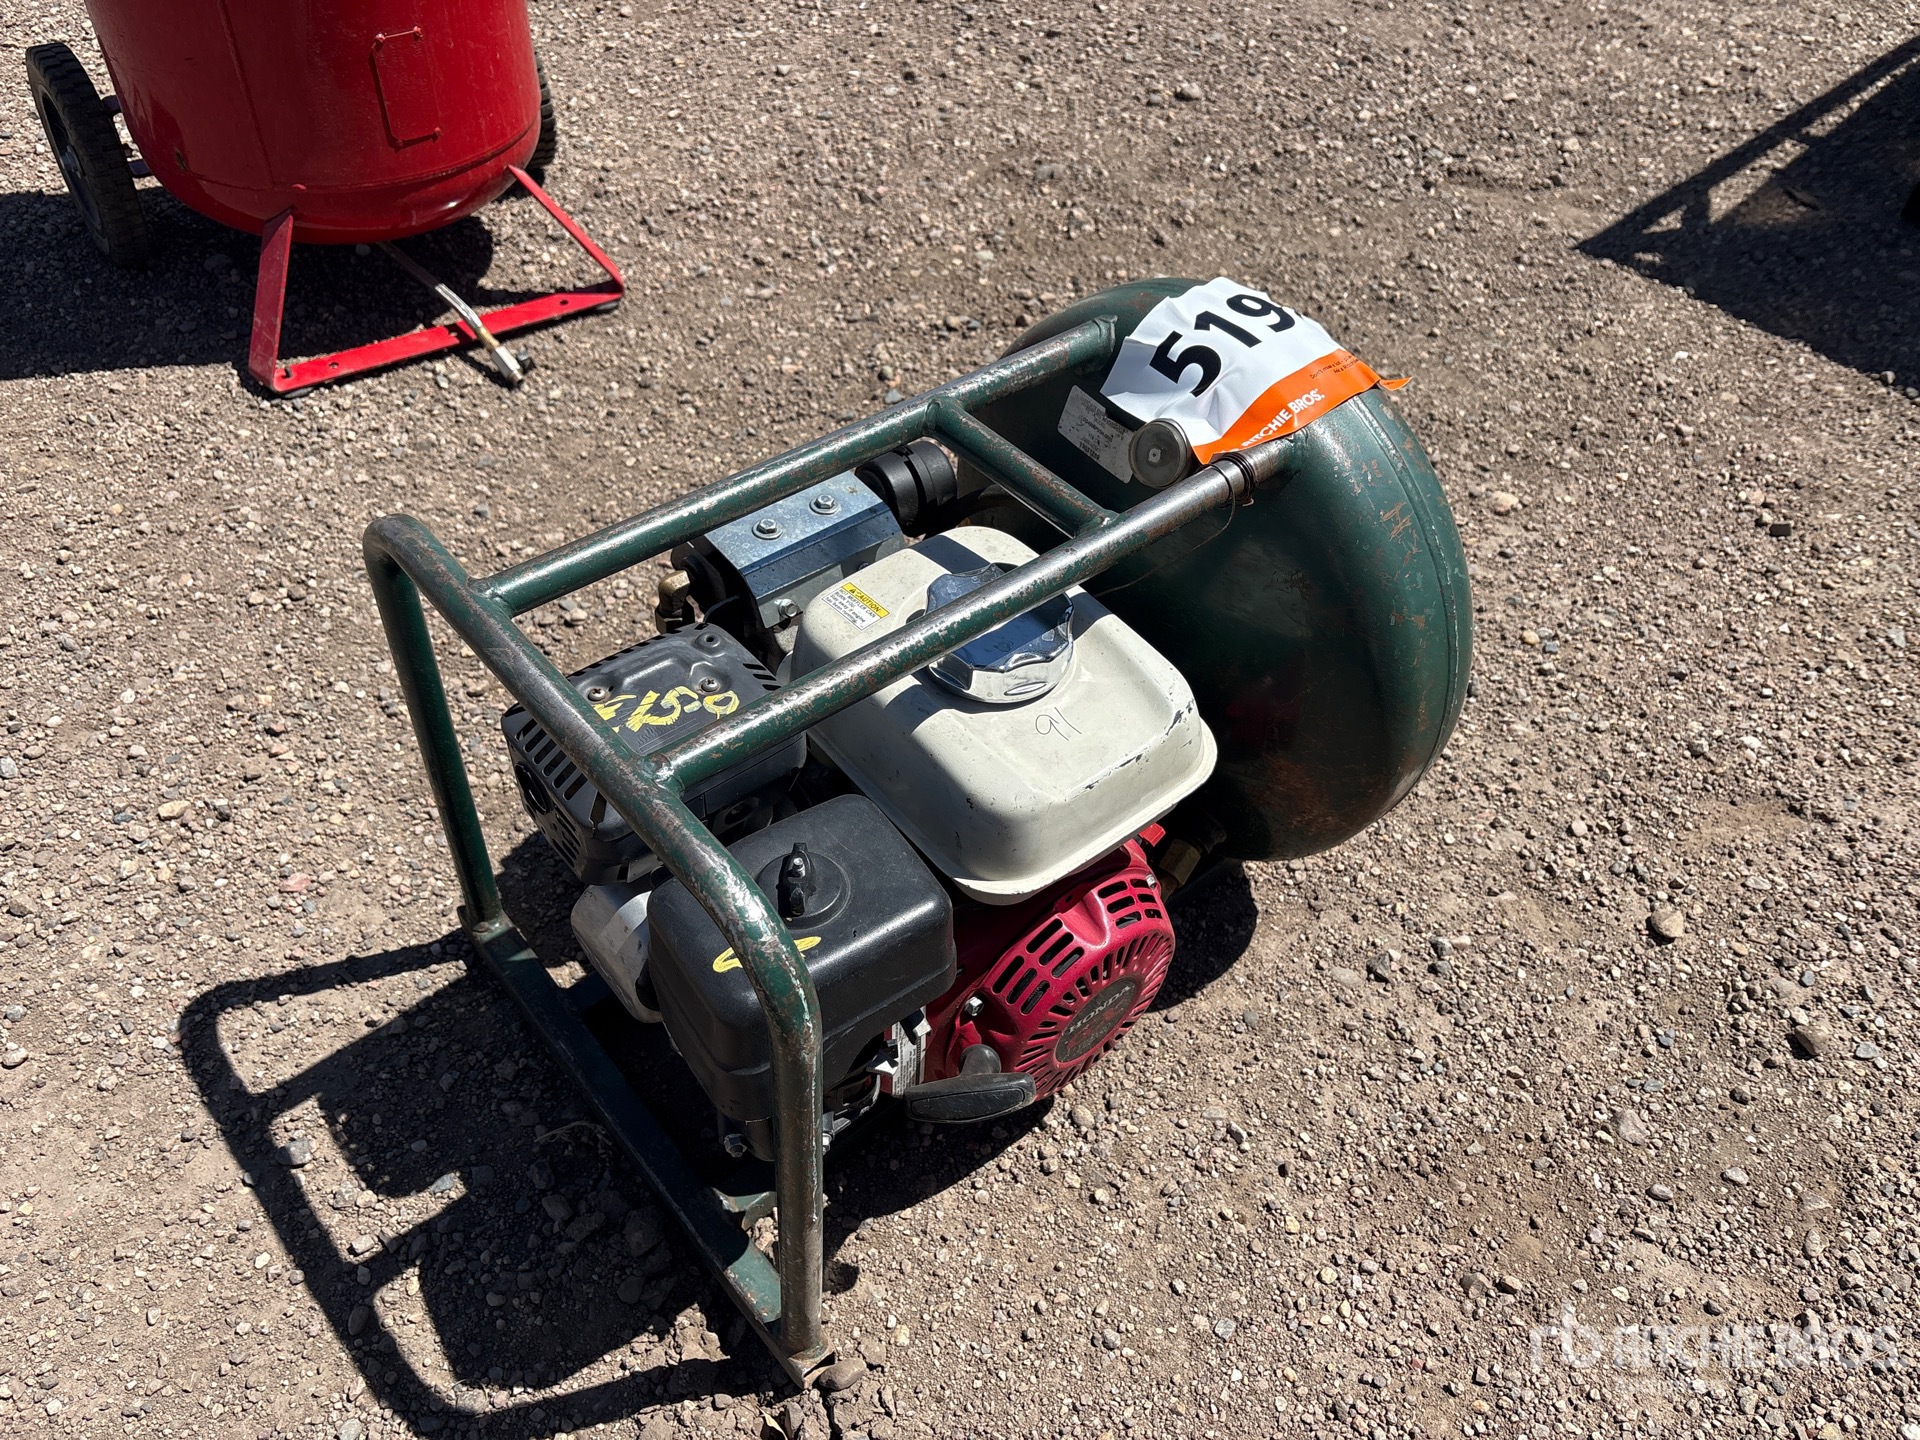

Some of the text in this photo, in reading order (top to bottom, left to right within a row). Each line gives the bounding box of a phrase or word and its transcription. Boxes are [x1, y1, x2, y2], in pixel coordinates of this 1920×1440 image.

[1149, 294, 1295, 398] 519
[853, 591, 882, 612] CAUTION
[1035, 706, 1082, 741] 91
[1069, 984, 1132, 1034] HONDA
